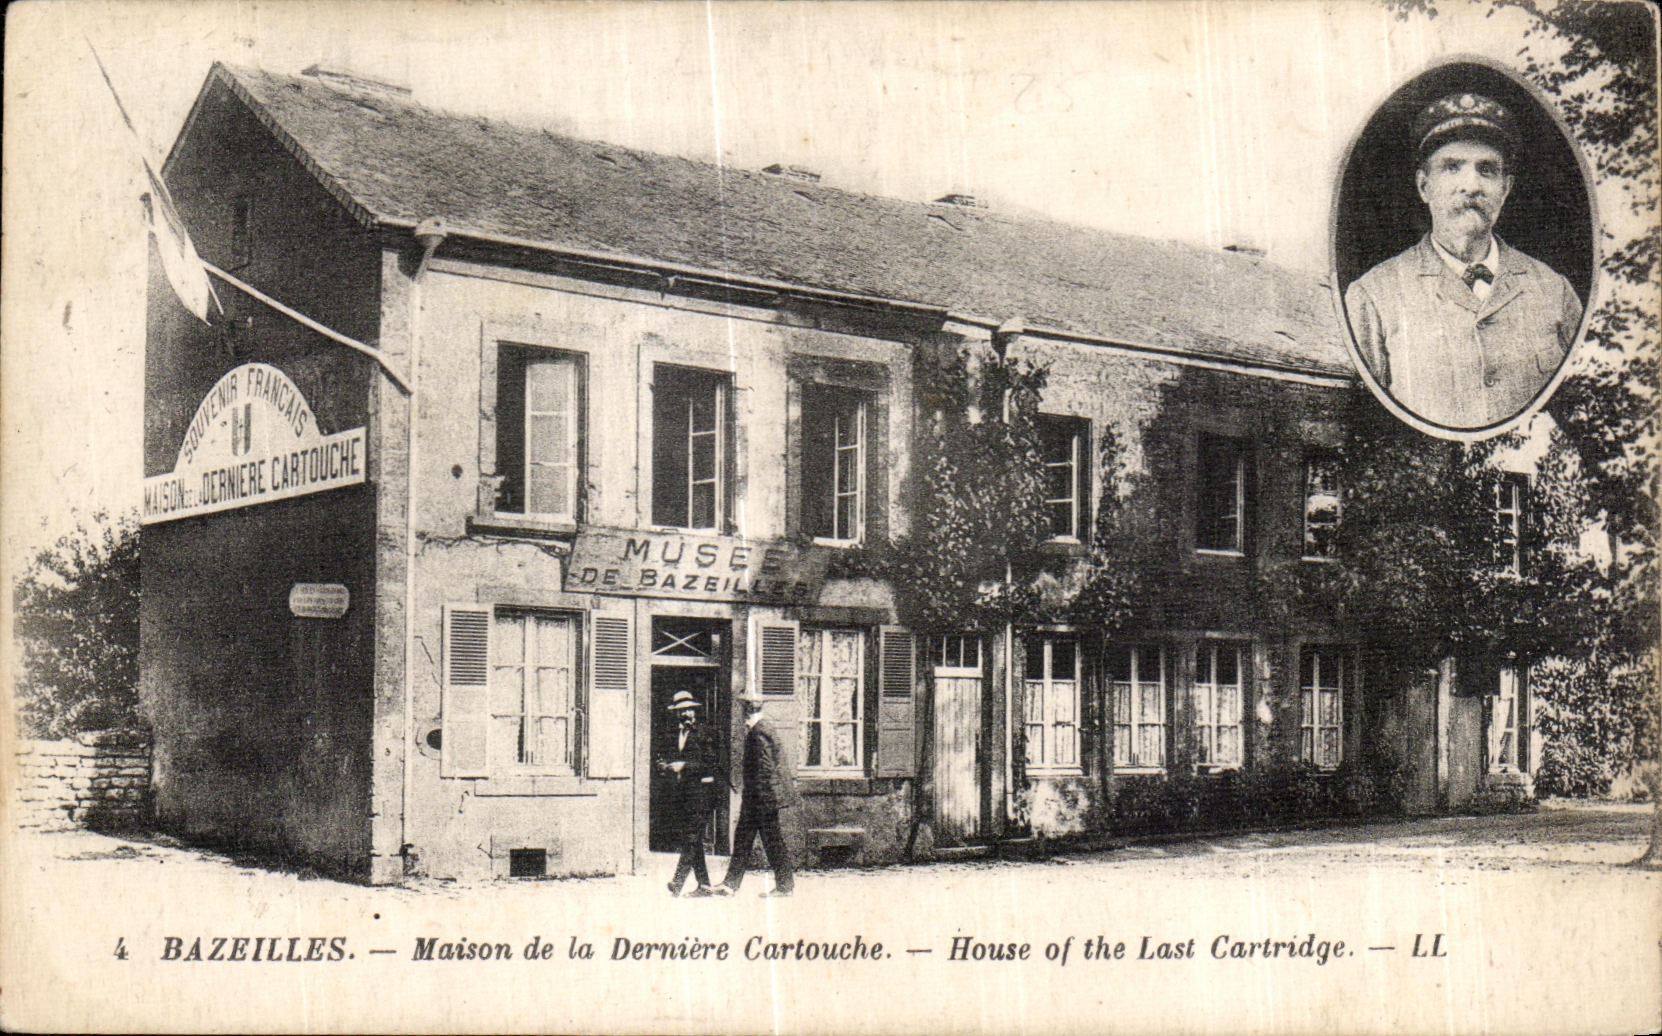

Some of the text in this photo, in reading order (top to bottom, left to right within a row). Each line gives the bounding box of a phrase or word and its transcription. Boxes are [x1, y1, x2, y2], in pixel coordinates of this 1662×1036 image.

[184, 373, 238, 464] SOUVENIR
[144, 477, 185, 516] MAISON
[202, 459, 266, 505] DERNIERE
[271, 437, 361, 491] CARTOUCHE
[580, 567, 808, 600] DE BAZEILLES
